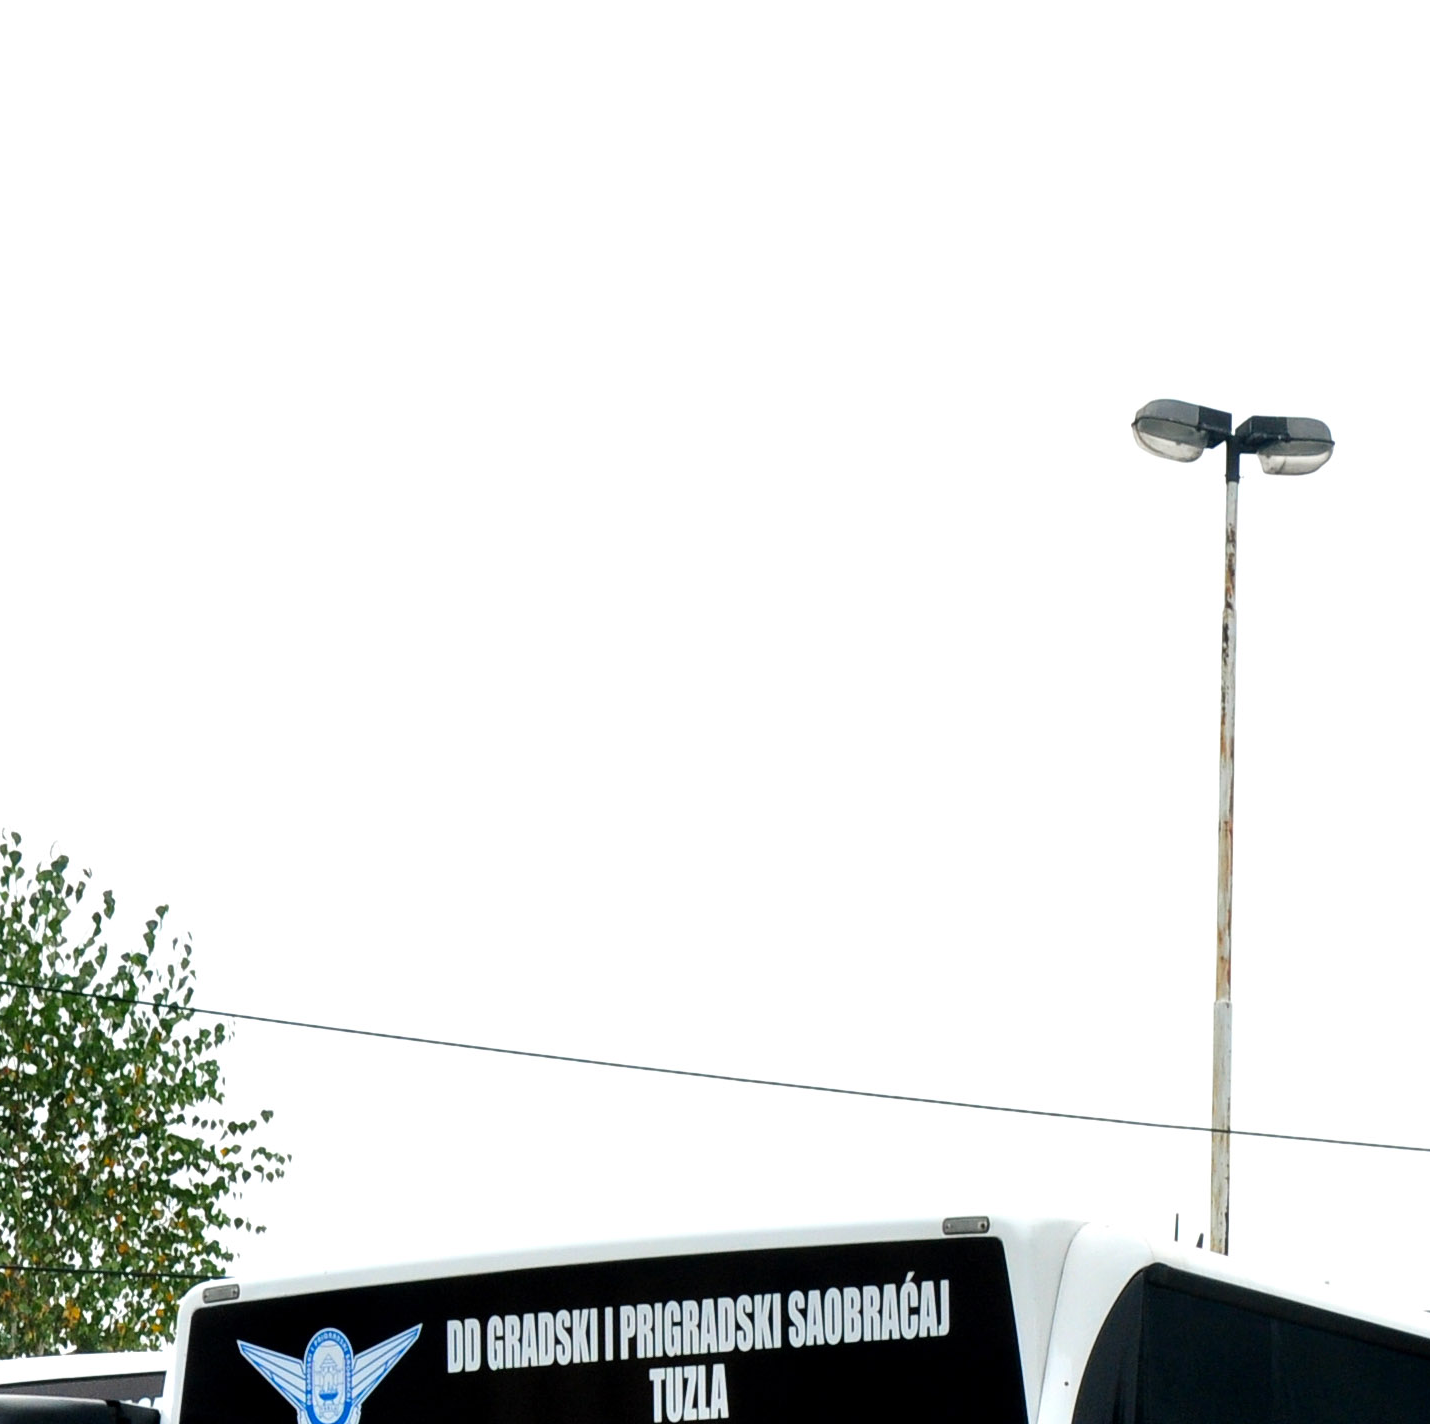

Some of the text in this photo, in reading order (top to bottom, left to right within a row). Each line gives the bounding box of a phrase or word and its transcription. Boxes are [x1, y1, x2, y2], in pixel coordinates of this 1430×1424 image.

[447, 1271, 950, 1374] DD GRADSKI I PRIGRADSKI SAOBRAĆAJ
[649, 1363, 729, 1424] TUZLA
